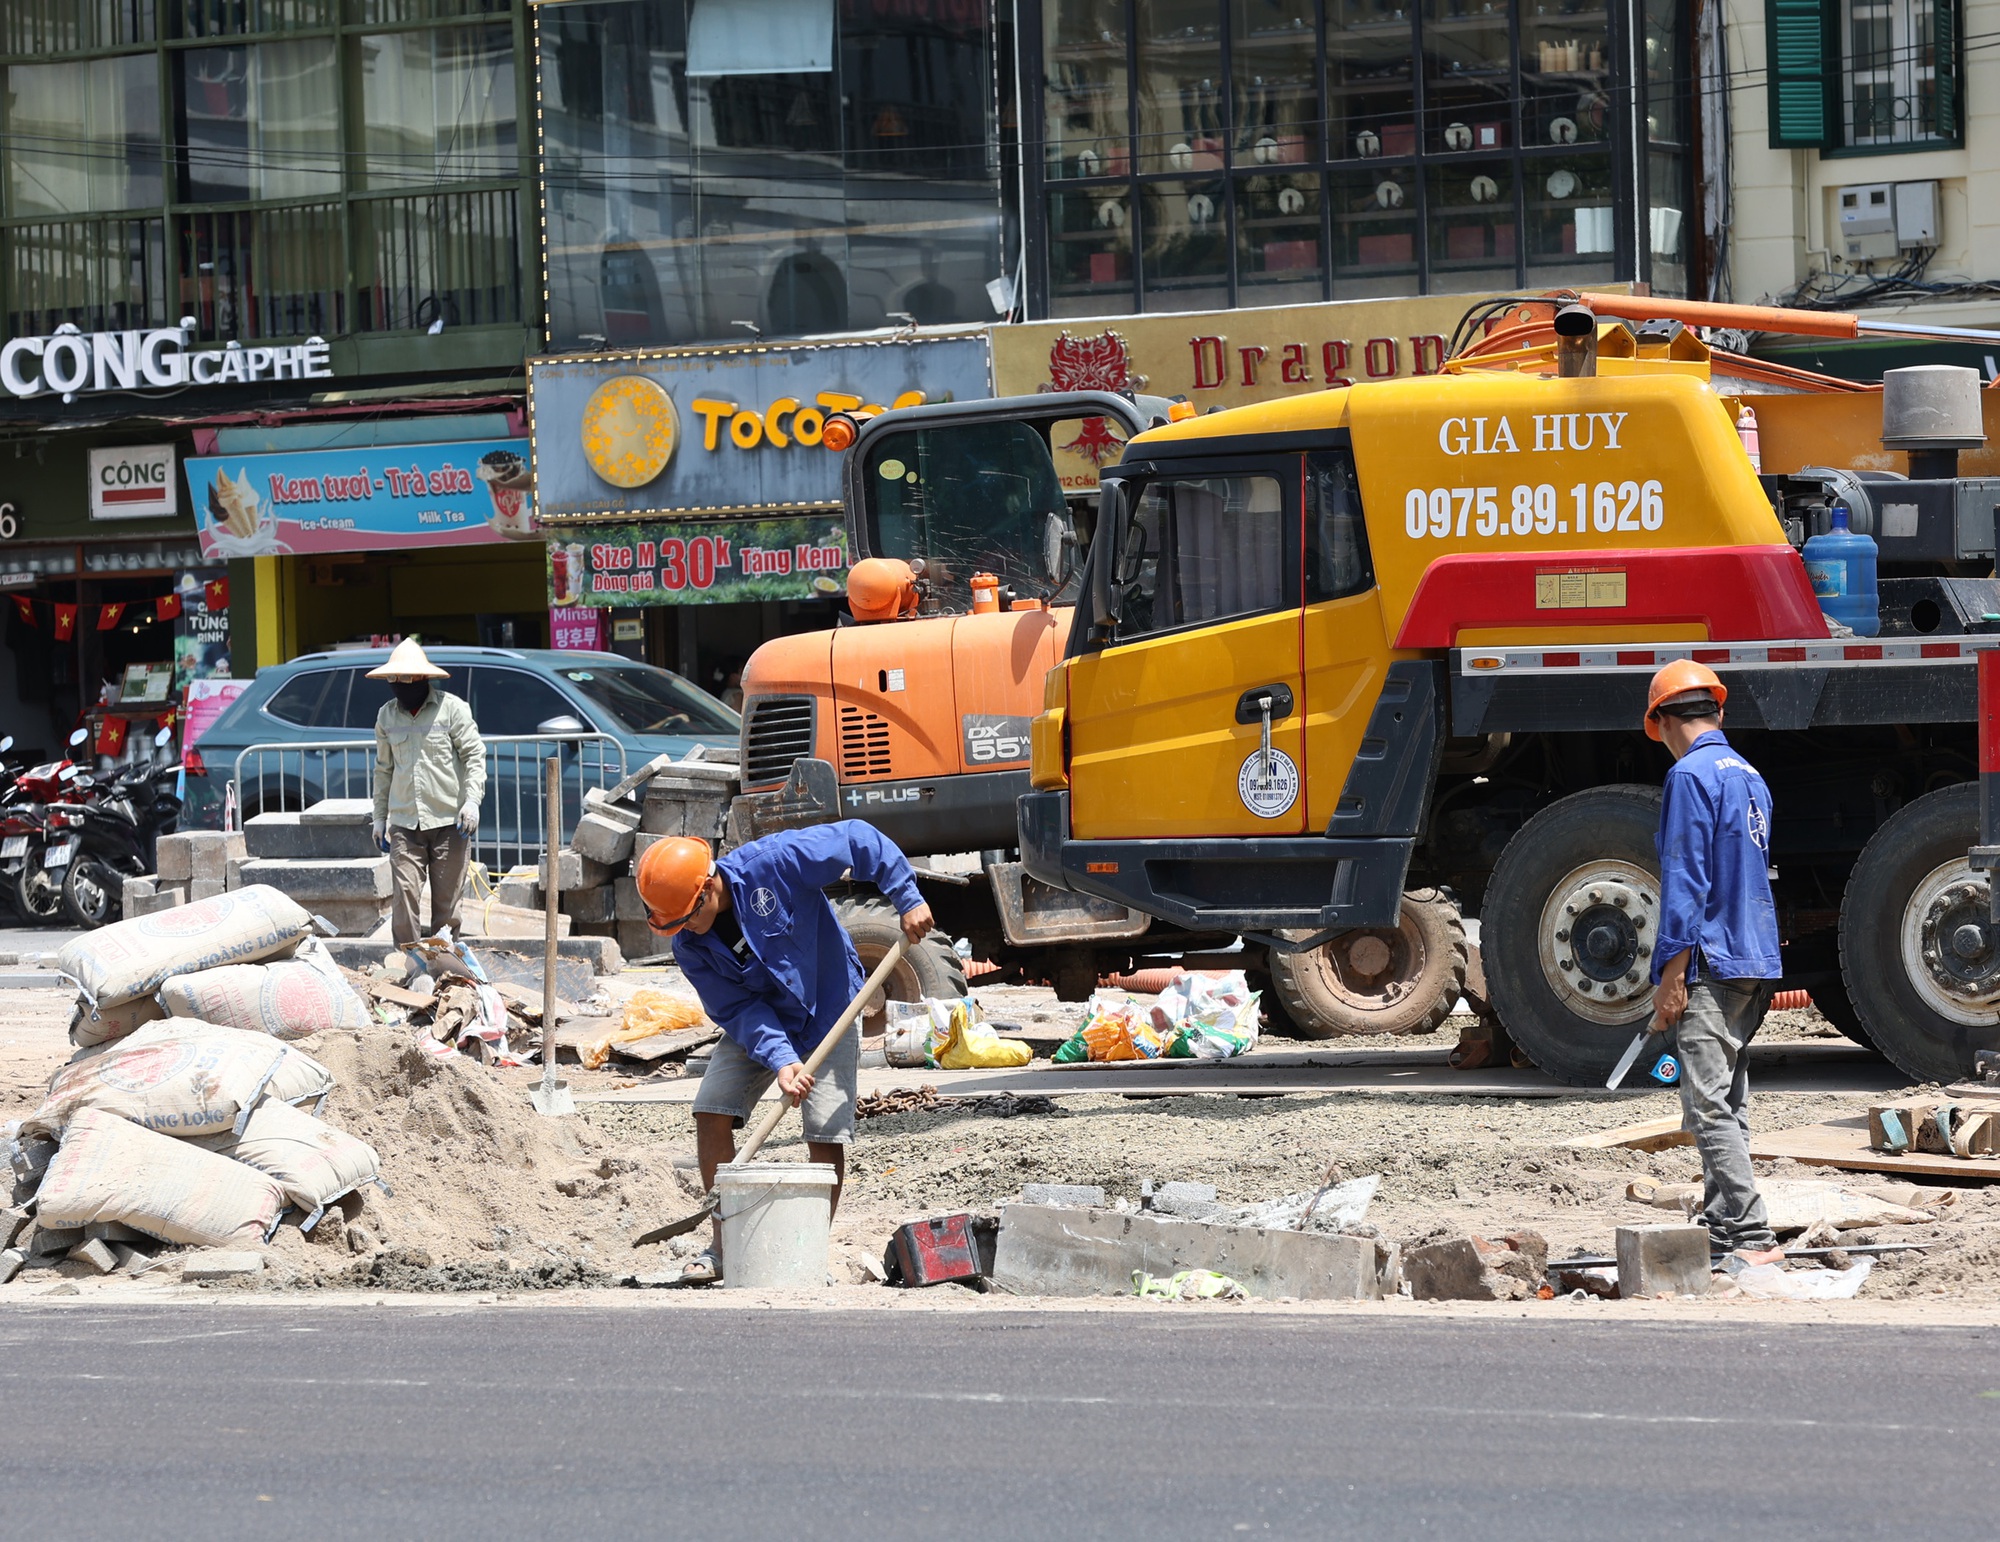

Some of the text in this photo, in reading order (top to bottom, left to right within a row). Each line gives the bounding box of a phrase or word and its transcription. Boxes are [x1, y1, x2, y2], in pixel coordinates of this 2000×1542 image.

[0, 322, 190, 404] CỘNG
[1189, 333, 1449, 389] Dragon
[1438, 412, 1629, 456] GIA HUY
[101, 460, 166, 490] CỘNG
[269, 472, 321, 503] Kem
[323, 467, 372, 499] tươi
[385, 465, 427, 498] Trà
[429, 463, 473, 496] sữa
[300, 509, 466, 531] Ice-Cream Milk Tea
[1405, 479, 1664, 540] 0975.89.1626
[591, 544, 631, 570] Size
[637, 542, 656, 569] M
[740, 547, 791, 578] Tặng
[796, 544, 842, 571] Kem
[630, 570, 655, 593] giá
[553, 608, 598, 622] Minsu
[197, 631, 224, 643] RINH
[555, 627, 597, 648] 탕후루
[967, 721, 1008, 739] DX
[197, 940, 254, 969] HOÀNG
[256, 924, 299, 950] LONG
